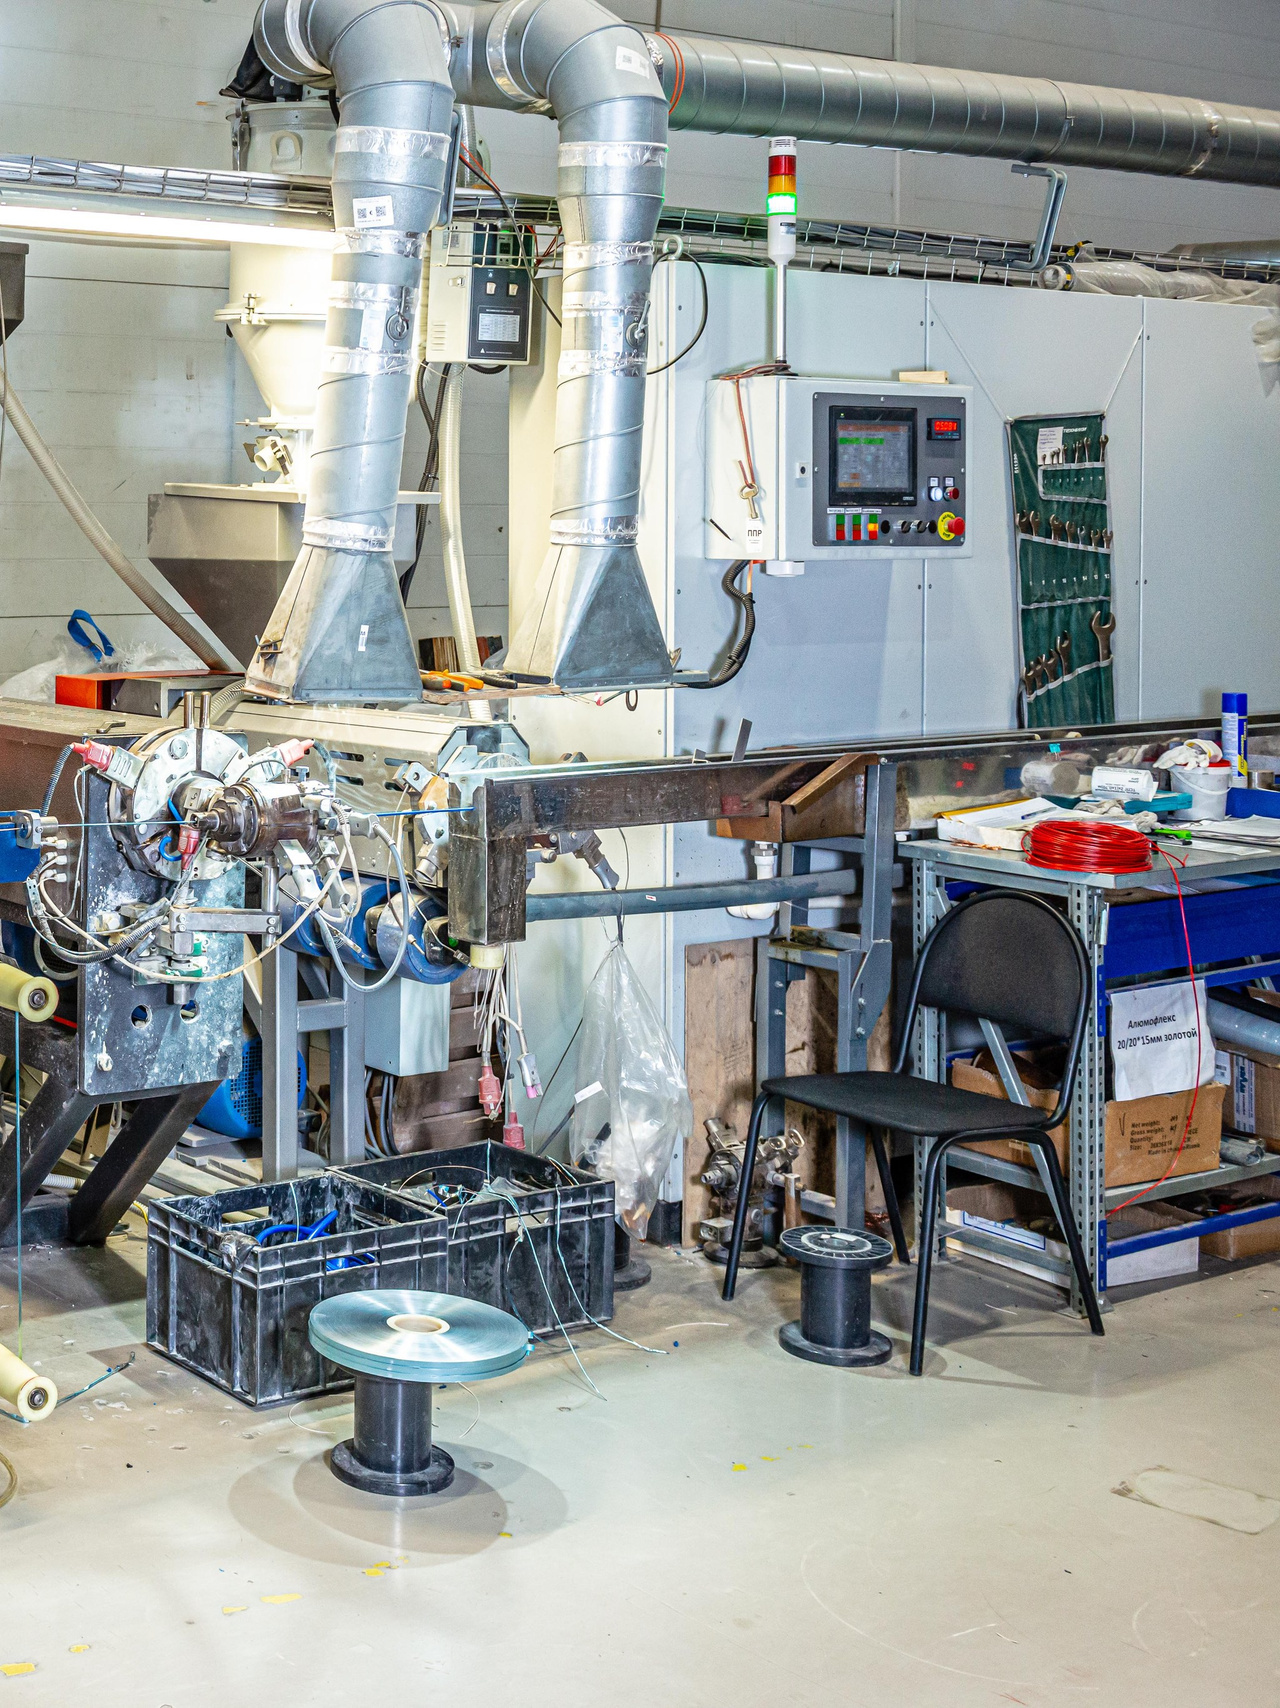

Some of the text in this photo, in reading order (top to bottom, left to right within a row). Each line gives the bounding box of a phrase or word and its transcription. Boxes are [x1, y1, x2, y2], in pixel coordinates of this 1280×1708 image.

[747, 529, 763, 537] ППР
[1127, 1014, 1177, 1030] Алюмофлекс
[1163, 1027, 1198, 1042] золотой
